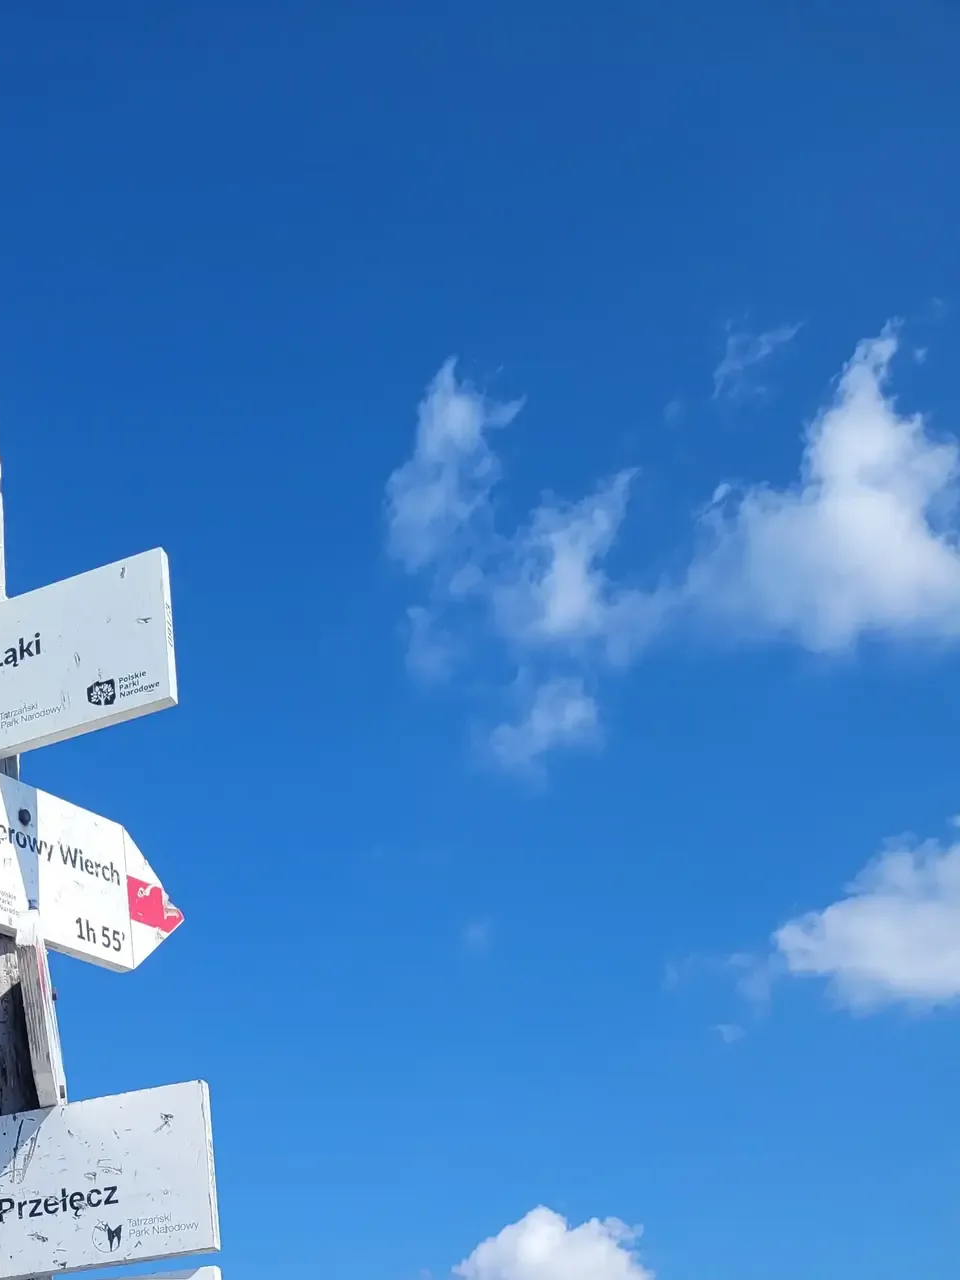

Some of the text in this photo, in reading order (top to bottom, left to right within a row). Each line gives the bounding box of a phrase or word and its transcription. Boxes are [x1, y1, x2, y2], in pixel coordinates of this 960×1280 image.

[118, 670, 146, 684] Polskie
[119, 680, 140, 692] Parki
[119, 680, 160, 698] Narodowe
[0, 702, 38, 721] Tatrzański
[0, 704, 62, 729] Park Narodowy
[58, 842, 121, 886] Wierch
[76, 917, 125, 952] 1h 55'
[126, 1212, 172, 1228] Tatrzański
[128, 1220, 200, 1238] Park Narodowy
